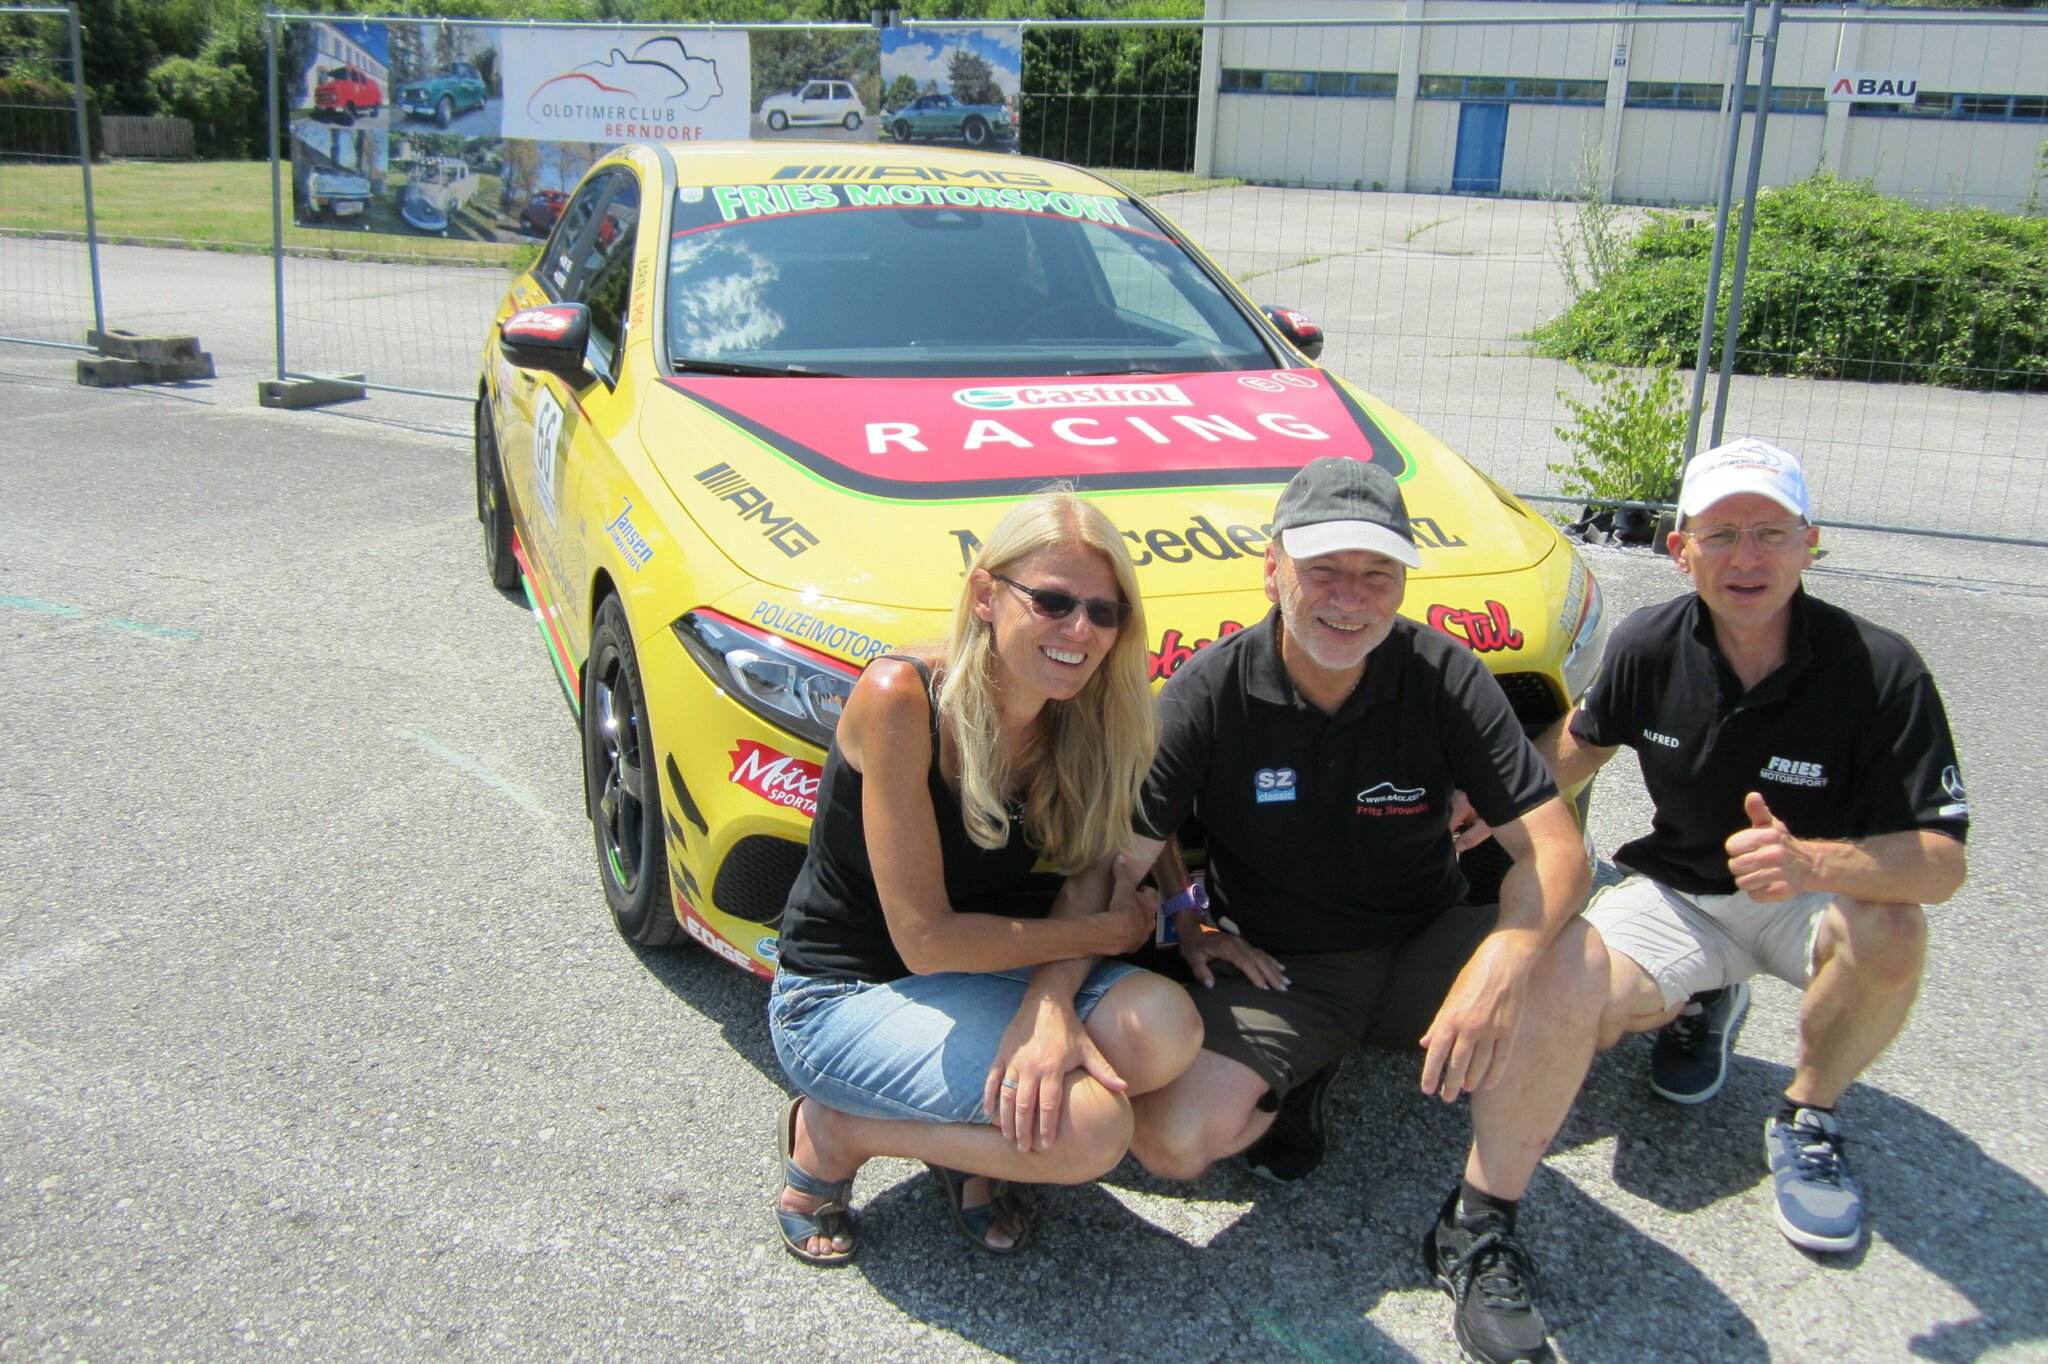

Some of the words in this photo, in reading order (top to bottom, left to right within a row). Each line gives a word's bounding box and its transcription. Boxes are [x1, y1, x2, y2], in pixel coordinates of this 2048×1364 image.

[542, 104, 675, 121] OLDTIMERCLUB
[605, 124, 702, 140] BERNDORF
[868, 166, 1054, 187] AMG
[712, 184, 839, 222] FRIES
[843, 185, 1129, 227] MOTORSPORT
[1016, 387, 1180, 405] Castrol
[864, 412, 1331, 454] RACING
[605, 496, 653, 563] Jansen
[720, 485, 820, 558] AMG
[751, 600, 893, 661] POLIZEIMOTORS
[1643, 729, 1680, 748] ALFRED
[1768, 756, 1822, 777] FRIES
[1258, 771, 1292, 788] SZ
[1760, 771, 1829, 787] MOTORSPORT
[1259, 791, 1294, 801] classic
[1357, 806, 1382, 816] Fritz
[686, 915, 755, 973] EDGE
